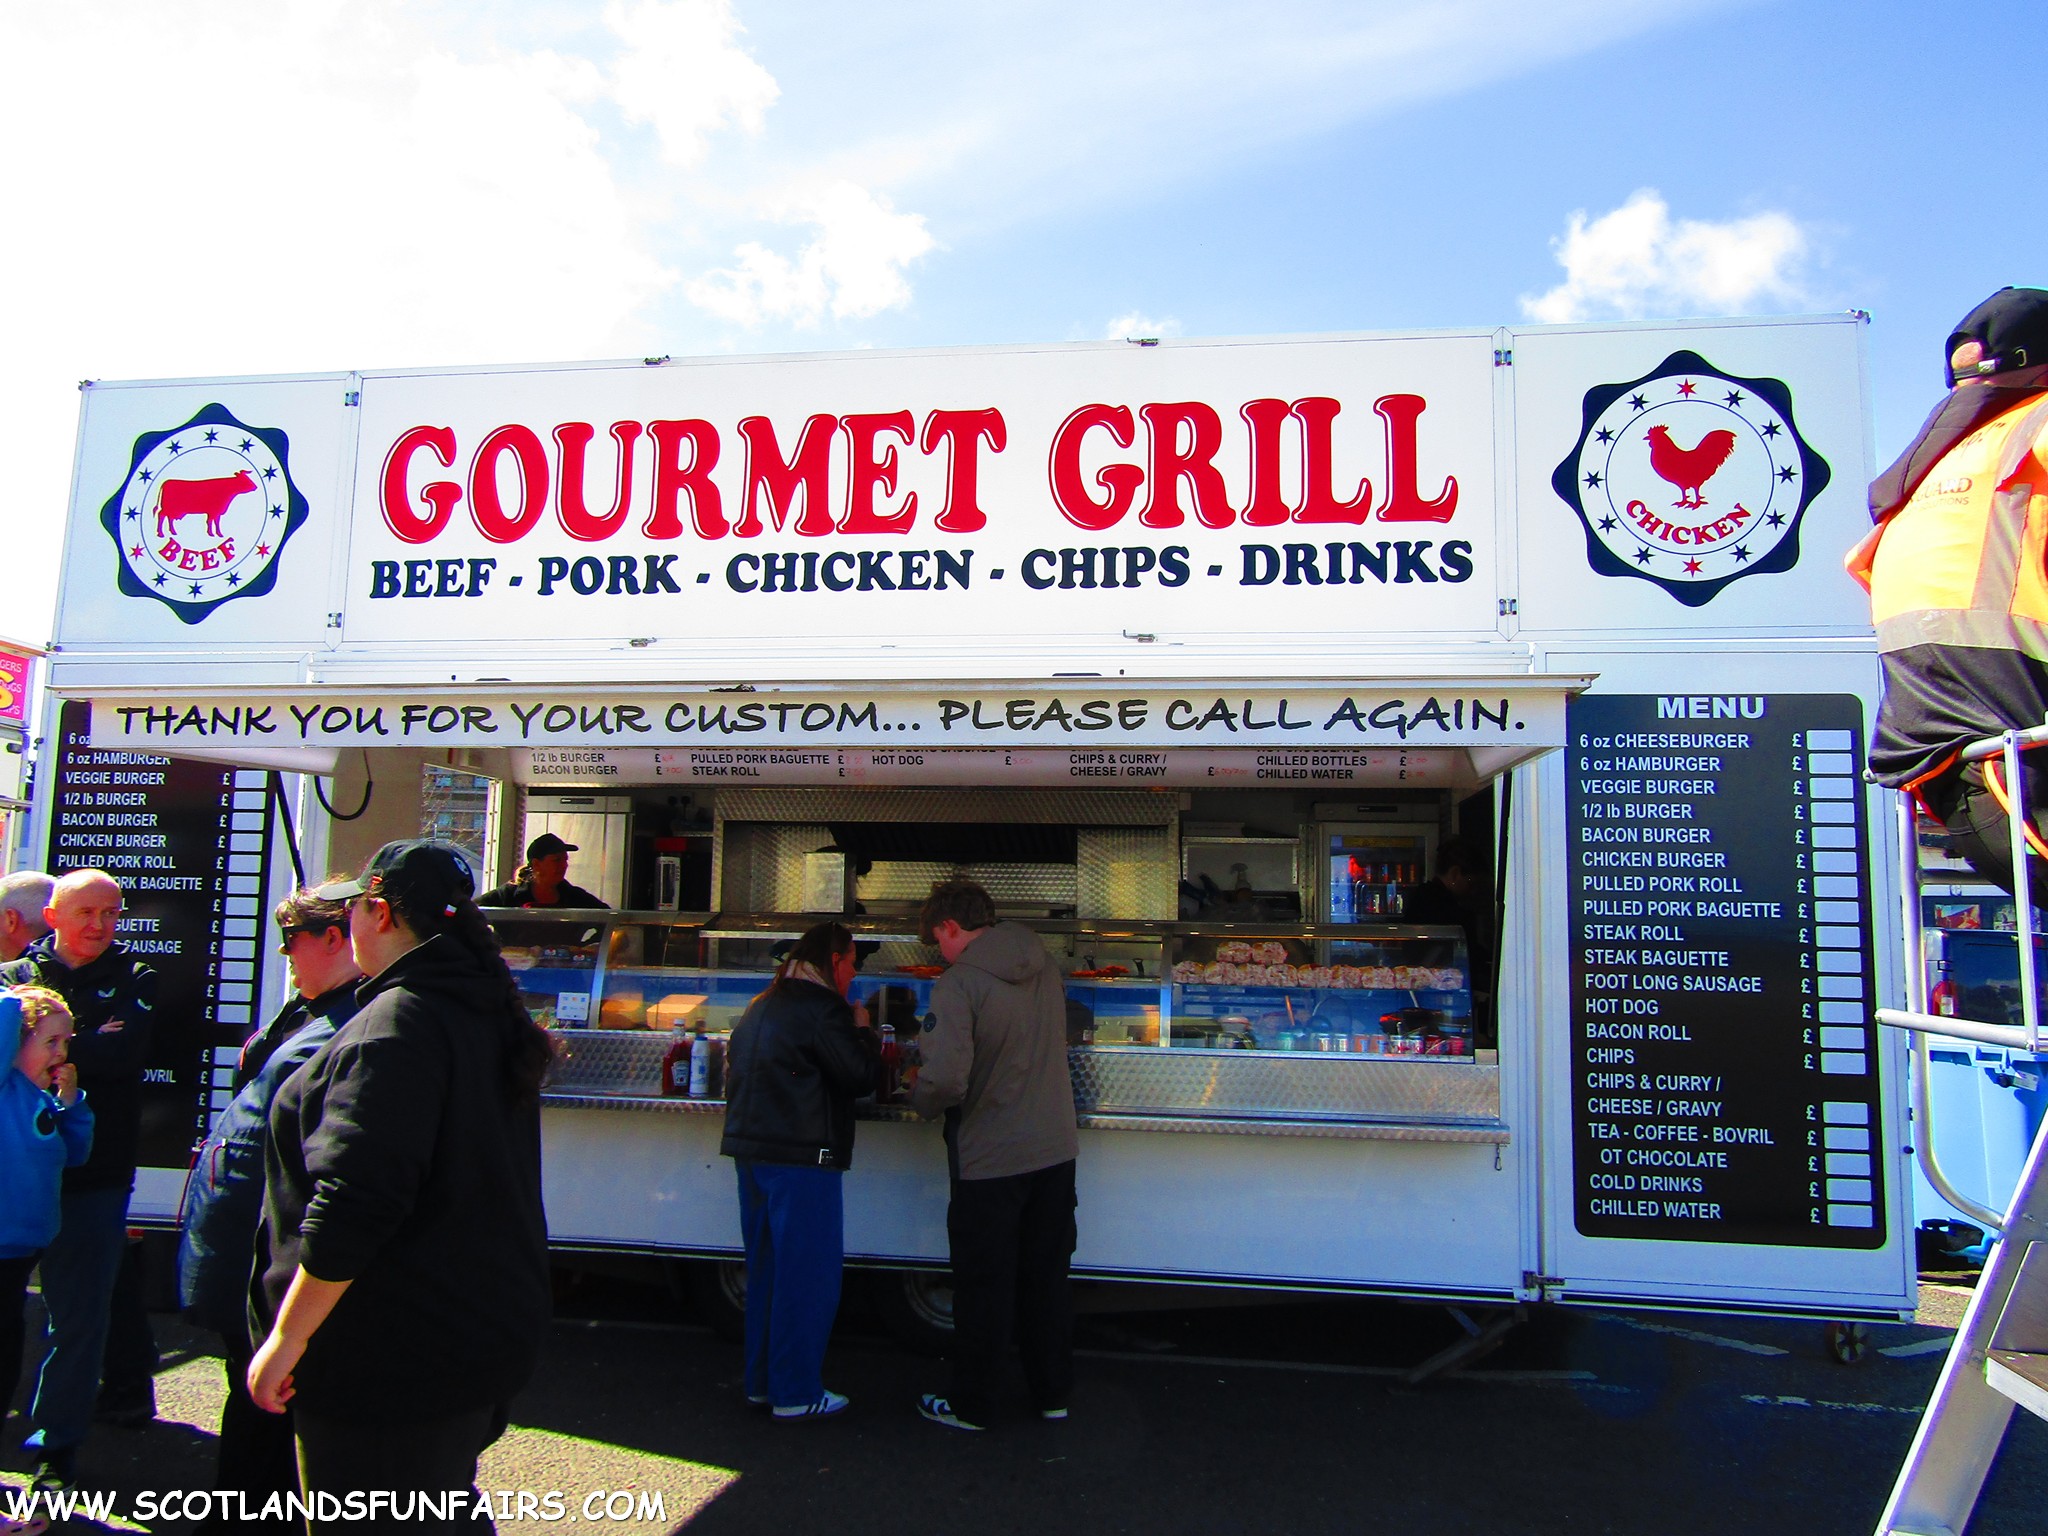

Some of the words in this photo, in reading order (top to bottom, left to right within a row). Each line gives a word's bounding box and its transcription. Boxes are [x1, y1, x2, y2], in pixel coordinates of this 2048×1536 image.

[379, 407, 1007, 544] GOURMET
[1048, 393, 1459, 531] GRILL
[1626, 500, 1751, 545] CHICKEN
[158, 537, 235, 571] BEEF
[369, 557, 497, 599] BEEF
[537, 553, 680, 596] PORK
[726, 549, 975, 593] CHICKEN
[1021, 546, 1191, 590] CHIPS
[1240, 540, 1474, 586] DRINKS
[1657, 697, 1764, 719] MENU
[117, 705, 277, 736] THANK
[289, 704, 385, 738] YOU
[401, 704, 498, 736] FOR
[512, 702, 654, 740] YOUR
[665, 701, 921, 733] CUSTOM...
[940, 699, 1148, 732] PLEASE
[1164, 698, 1311, 731] CALL
[1324, 697, 1526, 738] AGAIN.
[69, 733, 76, 744] 6
[1580, 734, 1588, 747] 6
[1593, 738, 1610, 747] oz
[1614, 734, 1749, 749] CHEESEBURGER
[1792, 734, 1801, 747] £
[67, 753, 74, 764] 6
[77, 756, 90, 764] oz
[93, 753, 171, 765] HAMBURGER
[532, 753, 545, 762] 1/2
[549, 753, 558, 762] lb
[561, 753, 605, 763] BURGER
[691, 754, 734, 763] PULLED
[736, 754, 767, 764] PORK
[771, 755, 829, 765] BAGUETTE
[872, 756, 895, 765] HOT
[898, 756, 924, 765] DOG
[1070, 754, 1106, 764] CHIPS
[1109, 754, 1117, 764] &
[1119, 755, 1160, 764] CURRY
[1257, 756, 1308, 766] CHILLED
[1312, 756, 1367, 766] BOTTLES
[1580, 757, 1588, 771] 6
[1594, 761, 1610, 771] oz
[1616, 757, 1720, 772] HAMBURGER
[1792, 756, 1801, 770] £
[533, 765, 570, 774] BACON
[573, 765, 618, 775] BURGER
[692, 766, 728, 776] STEAK
[731, 766, 760, 776] ROLL
[1070, 766, 1117, 776] CHEESE
[1127, 766, 1166, 776] GRAVY
[1256, 769, 1308, 779] CHILLED
[1312, 769, 1353, 779] WATER
[66, 772, 110, 784] VEGGIE
[114, 772, 165, 785] BURGER
[223, 773, 230, 785] £
[1581, 780, 1641, 794] VEGGIE
[1646, 780, 1715, 795] BURGER
[1793, 780, 1802, 795] £
[64, 793, 81, 805] 1/2
[83, 793, 93, 805] lb
[97, 793, 146, 805] BURGER
[222, 794, 228, 806] £
[1582, 804, 1602, 818] 1/2
[1607, 804, 1620, 818] lb
[1625, 805, 1692, 819] BURGER
[1794, 805, 1803, 819] £
[62, 814, 104, 825] BACON
[108, 814, 157, 826] BURGER
[220, 815, 227, 827] £
[60, 834, 112, 846] CHICKEN
[116, 835, 166, 847] BURGER
[218, 836, 225, 848] £
[1582, 828, 1638, 843] BACON
[1643, 829, 1710, 843] BURGER
[1795, 830, 1804, 844] £
[58, 855, 105, 867] PULLED
[108, 856, 141, 868] PORK
[145, 856, 176, 868] ROLL
[217, 857, 224, 869] £
[1583, 852, 1652, 867] CHICKEN
[1657, 853, 1725, 868] BURGER
[1796, 854, 1805, 869] £
[114, 876, 138, 889] ORK
[140, 877, 203, 890] BAGUETTE
[215, 878, 222, 890] £
[1583, 876, 1644, 891] PULLED
[1650, 877, 1694, 892] PORK
[1700, 878, 1742, 893] ROLL
[1797, 879, 1806, 893] £
[1584, 901, 1643, 915] PULLED
[1648, 901, 1692, 916] PORK
[1697, 902, 1781, 918] BAGUETTE
[1798, 904, 1808, 918] £
[115, 918, 160, 932] GUETTE
[212, 920, 219, 933] £
[1584, 925, 1636, 940] STEAK
[1641, 925, 1684, 941] ROLL
[1799, 928, 1808, 943] £
[210, 942, 218, 954] £
[1584, 949, 1637, 964] STEAK
[1642, 950, 1728, 967] BAGUETTE
[1800, 953, 1810, 968] £
[1585, 974, 1628, 989] FOOT
[1633, 975, 1678, 990] LONG
[1683, 976, 1761, 992] SAUSAGE
[1801, 979, 1811, 993] £
[1586, 999, 1618, 1014] HOT
[1623, 1000, 1659, 1015] DOG
[1802, 1004, 1812, 1018] £
[1586, 1023, 1643, 1039] BACON
[1649, 1025, 1691, 1041] ROLL
[1803, 1029, 1812, 1044] £
[1587, 1048, 1634, 1064] CHIPS
[1804, 1054, 1813, 1069] £
[144, 1069, 176, 1082] OVRIL
[201, 1071, 208, 1084] £
[1587, 1073, 1635, 1089] CHIPS
[1640, 1075, 1651, 1089] &
[1656, 1075, 1711, 1091] CURRY
[1716, 1076, 1720, 1091] /
[1588, 1098, 1652, 1115] CHEESE
[1657, 1100, 1662, 1115] /
[1667, 1100, 1721, 1116] GRAVY
[1806, 1105, 1816, 1120] £
[1588, 1123, 1619, 1138] TEA
[1634, 1125, 1698, 1142] COFFEE
[1713, 1127, 1774, 1144] BOVRIL
[1807, 1131, 1817, 1146] £
[1627, 1150, 1727, 1168] CHOCOLATE
[1808, 1157, 1818, 1171] £
[1590, 1174, 1635, 1190] COLD
[1641, 1175, 1702, 1192] DRINKS
[1809, 1182, 1819, 1197] £
[1591, 1199, 1659, 1217] CHILLED
[1663, 1201, 1721, 1219] WATER
[1810, 1208, 1820, 1223] £
